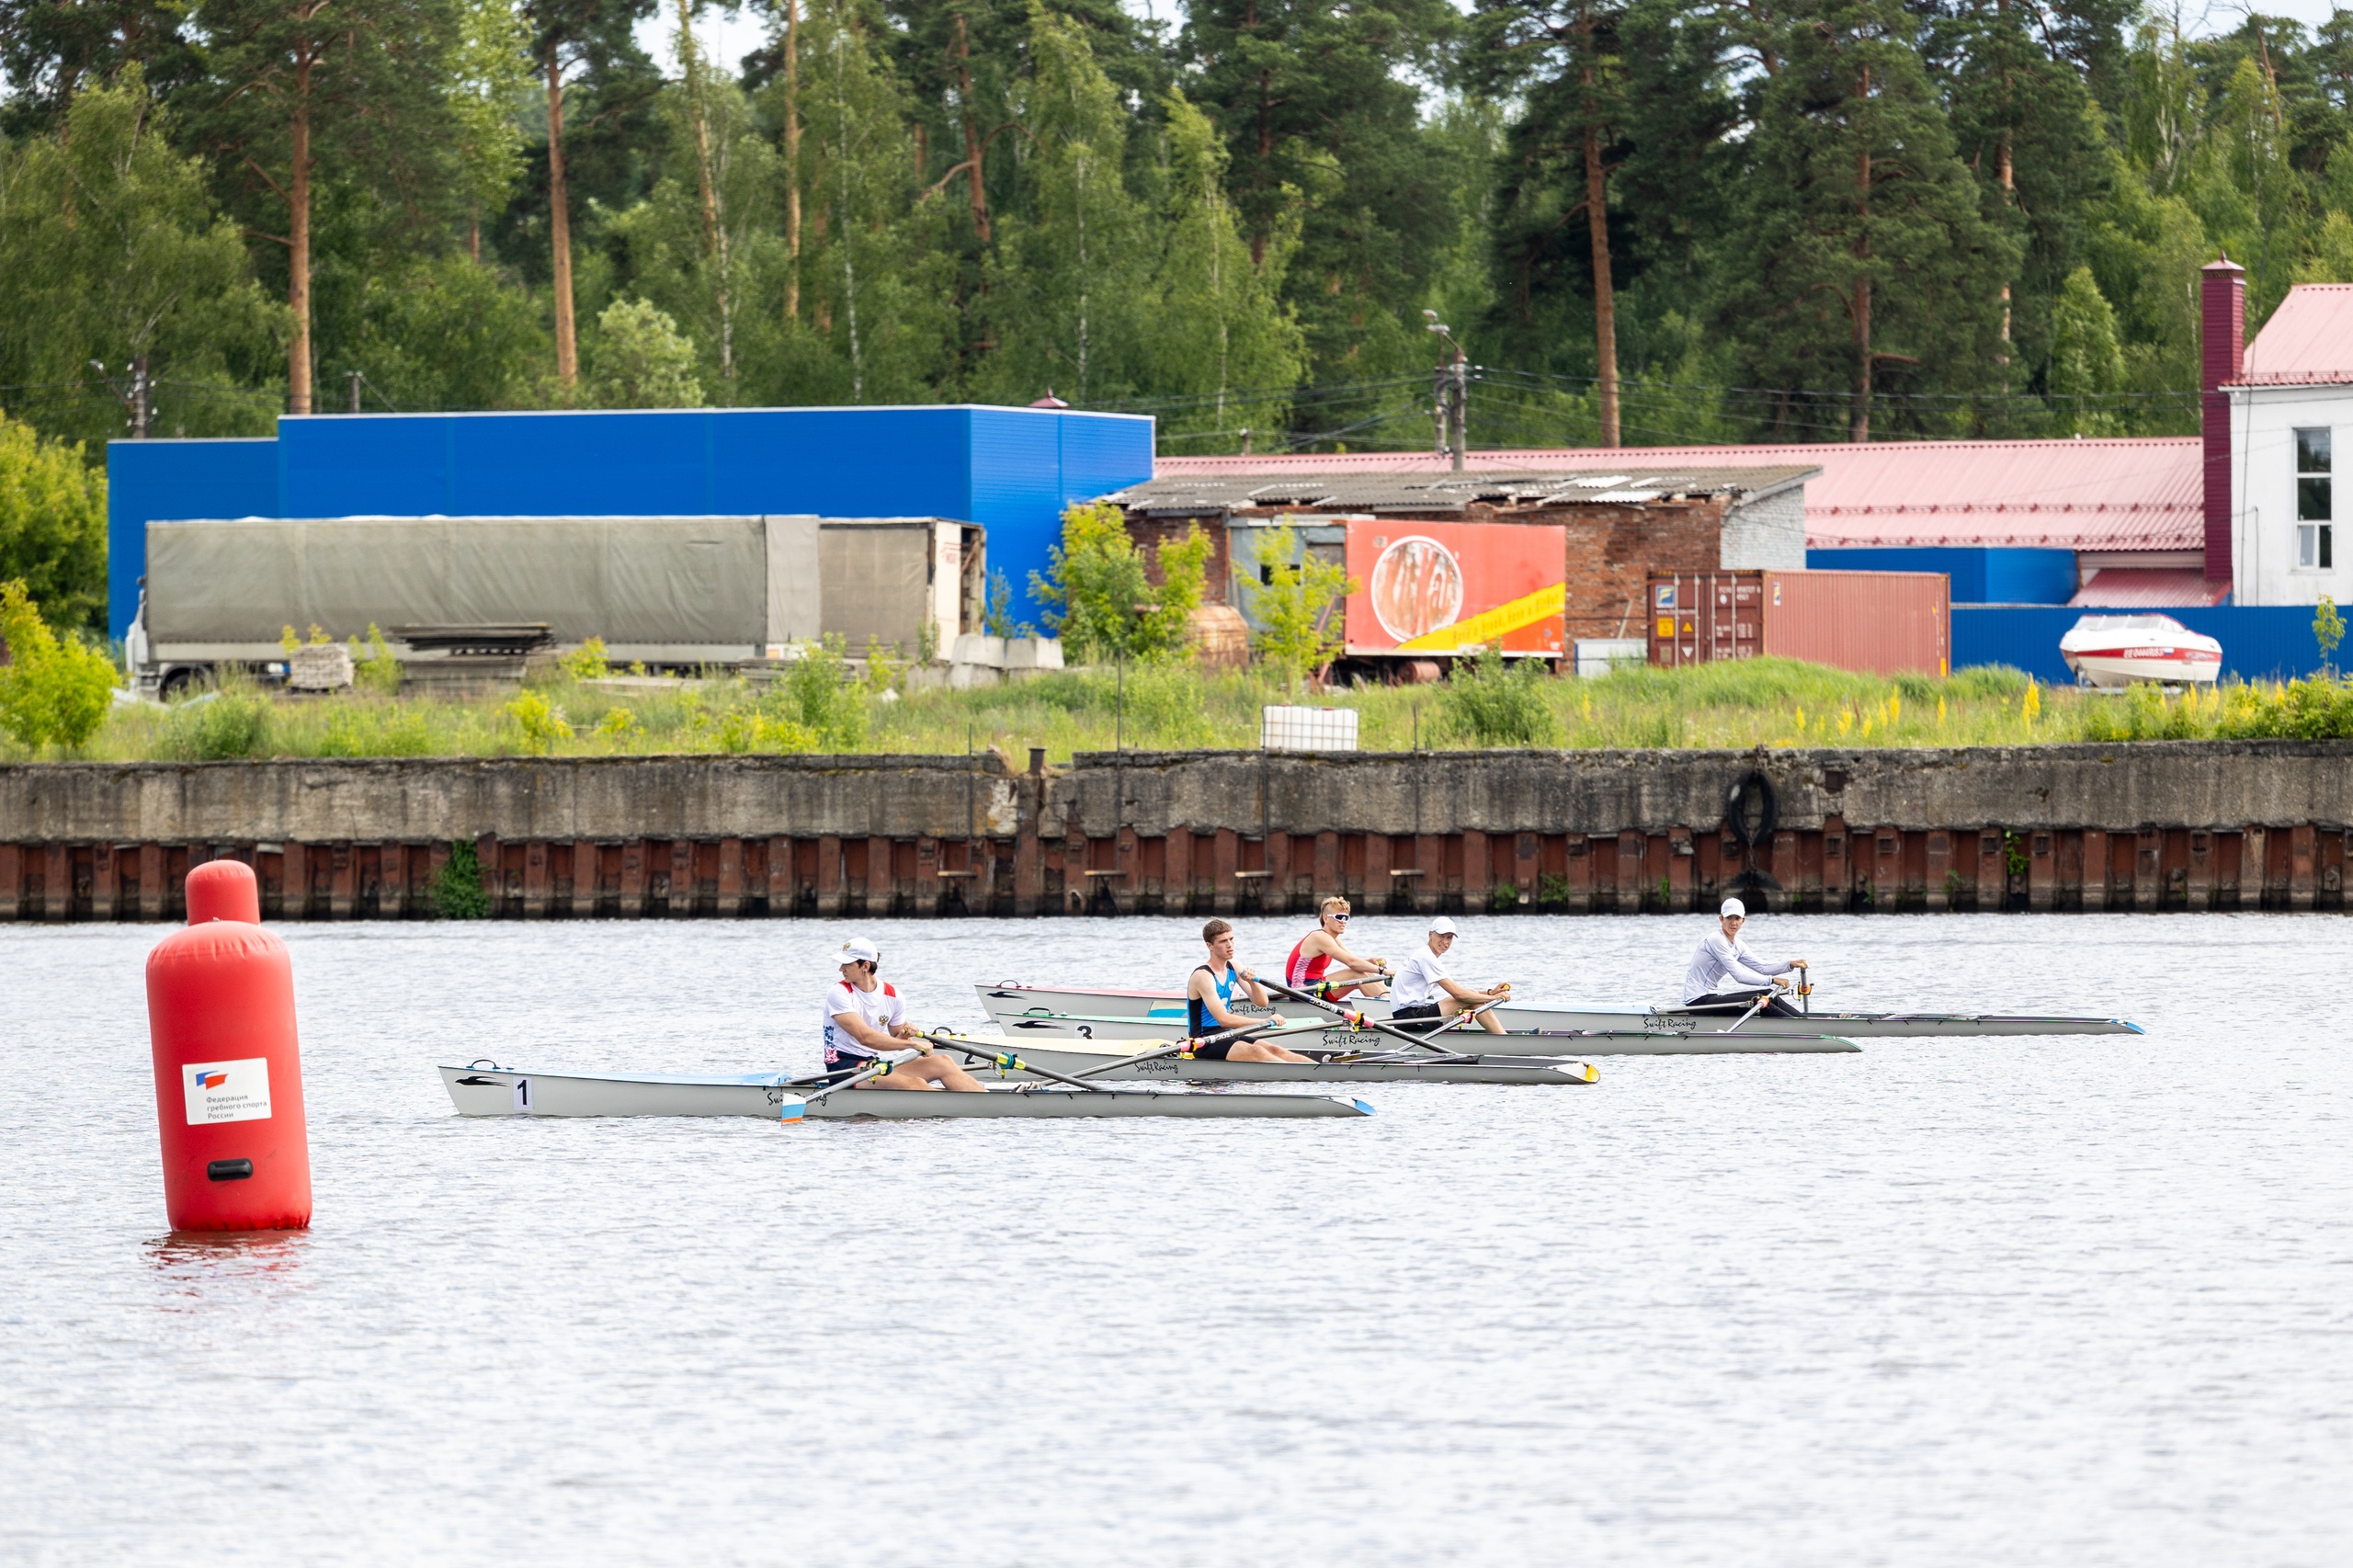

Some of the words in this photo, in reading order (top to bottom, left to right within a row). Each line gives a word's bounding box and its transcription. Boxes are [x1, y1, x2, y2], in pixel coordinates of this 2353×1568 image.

[1230, 1004, 1250, 1016] Swift
[1250, 1004, 1277, 1016] Racing
[1643, 1017, 1666, 1030] Swift
[1667, 1017, 1697, 1030] Racing
[1322, 1034, 1347, 1048] Swift
[1348, 1034, 1381, 1047] Racing
[1134, 1061, 1154, 1074] Swift
[1154, 1061, 1178, 1074] Racing
[206, 1095, 248, 1103] Федерация
[517, 1079, 528, 1106] 1
[207, 1104, 241, 1112] гребного
